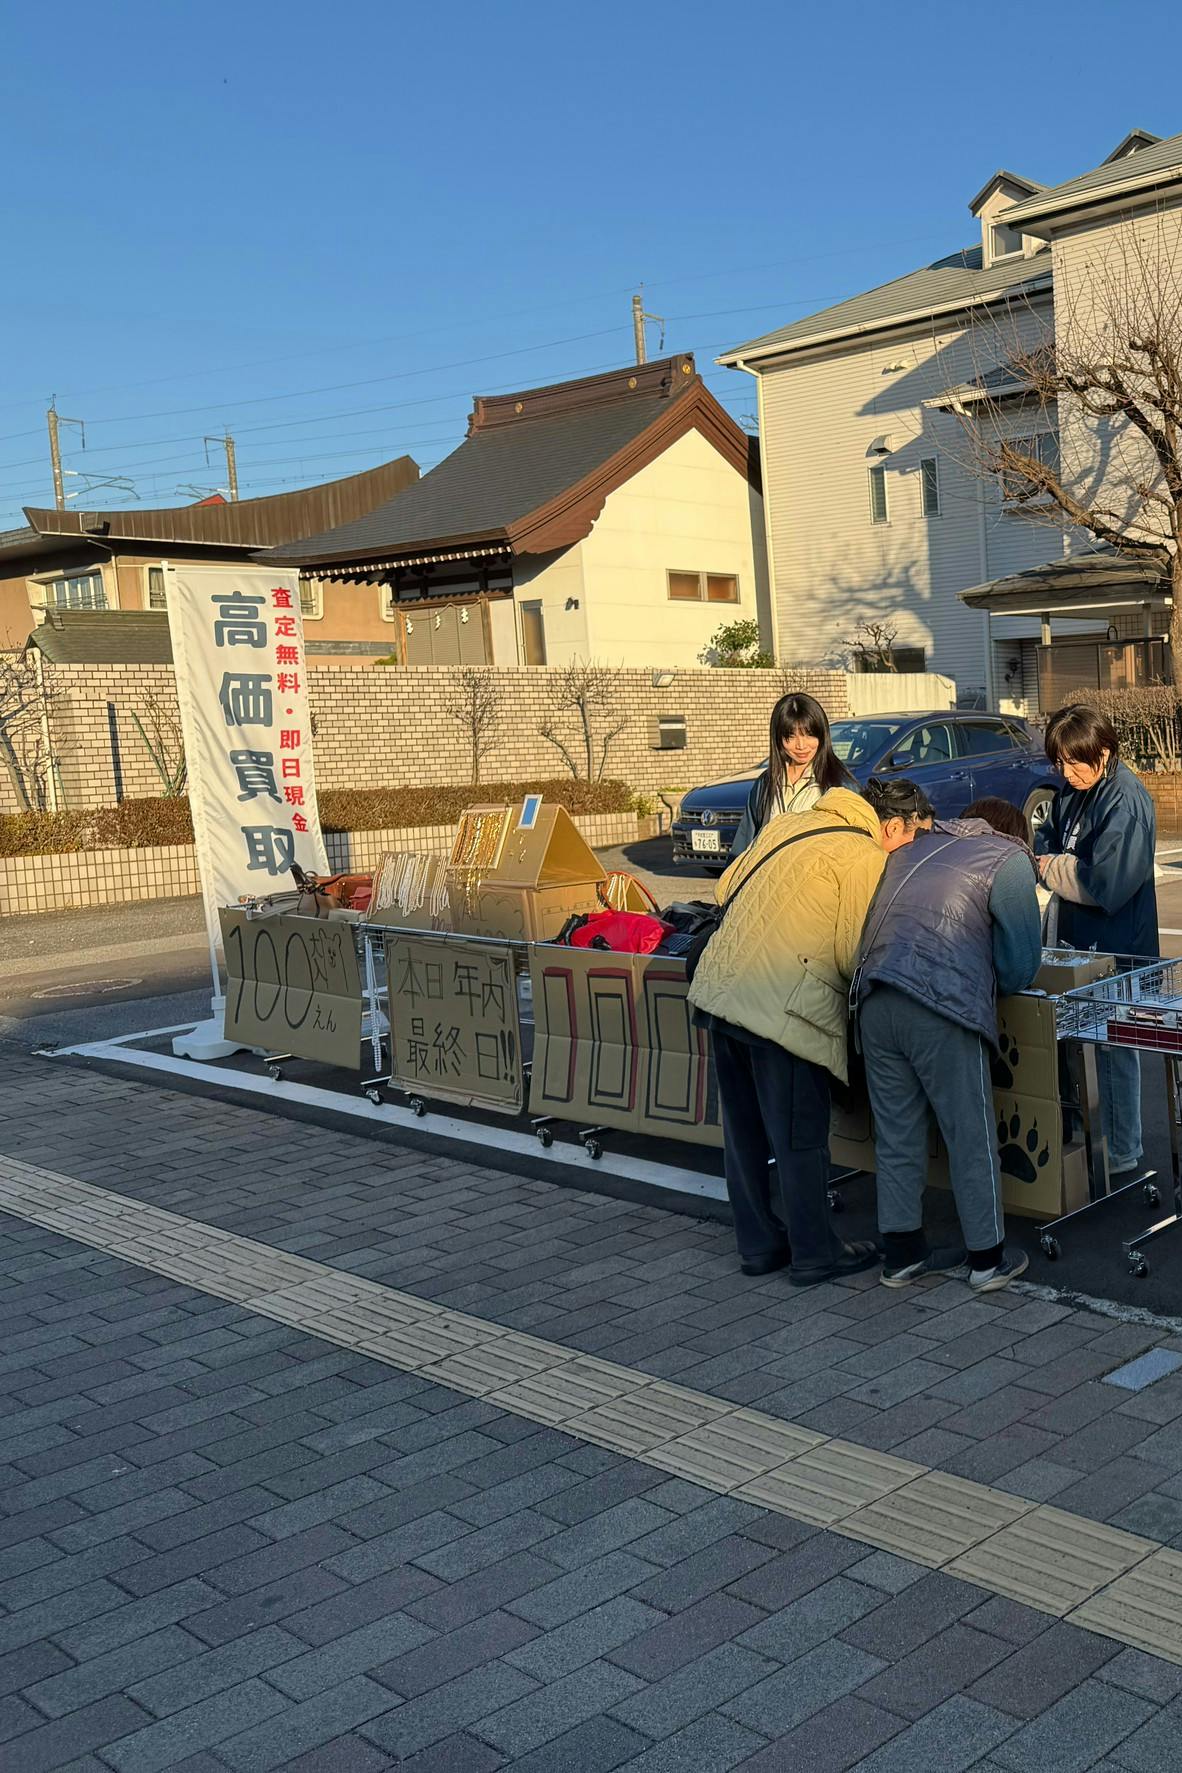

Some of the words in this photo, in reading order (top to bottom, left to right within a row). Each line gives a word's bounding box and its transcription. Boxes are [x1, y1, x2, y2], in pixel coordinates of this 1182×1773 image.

[211, 590, 296, 876] 高価買取
[271, 587, 309, 832] 査定無料・即日現金
[229, 925, 315, 1029] 100
